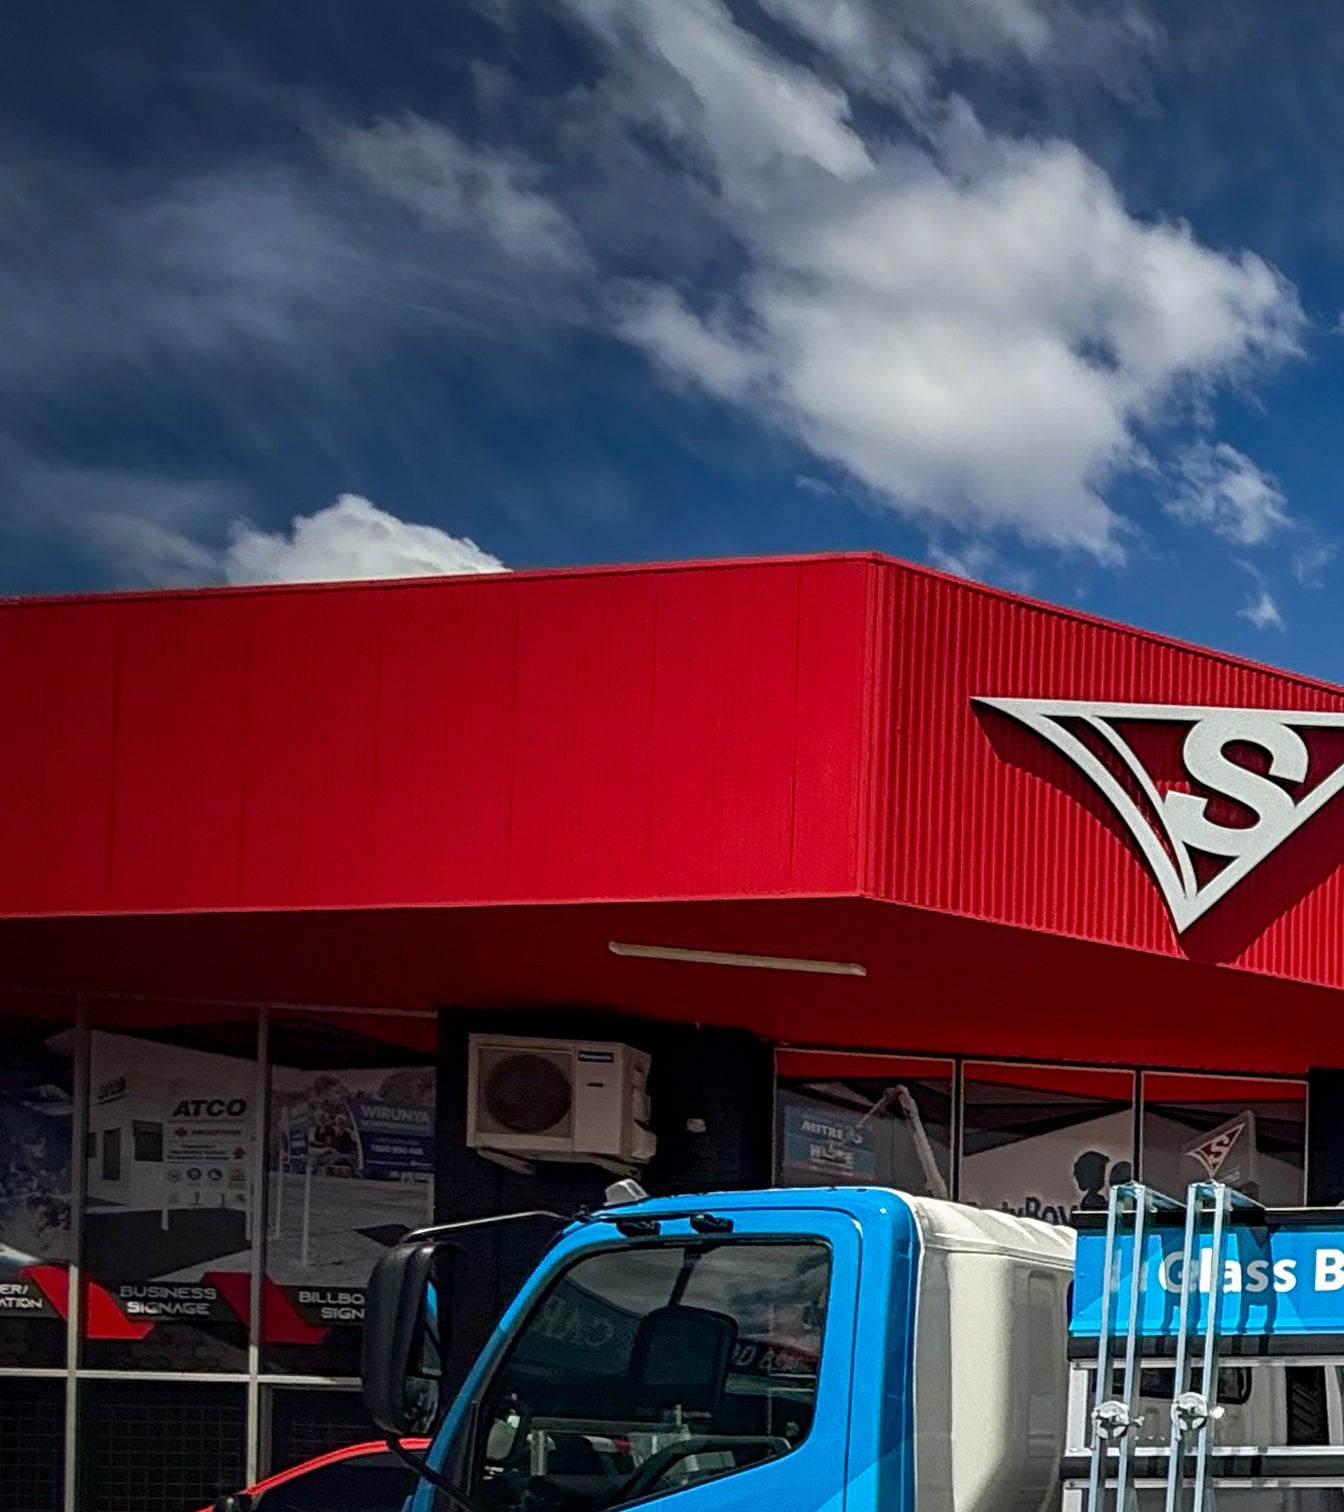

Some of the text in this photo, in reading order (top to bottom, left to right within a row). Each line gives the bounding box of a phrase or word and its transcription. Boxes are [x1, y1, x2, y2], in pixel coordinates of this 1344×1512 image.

[172, 1099, 247, 1117] ATCO
[361, 1104, 430, 1123] WIRUNYA
[1158, 1246, 1297, 1294] Glass
[120, 1285, 217, 1300] BUSINESS
[126, 1301, 211, 1316] SIGNAGE
